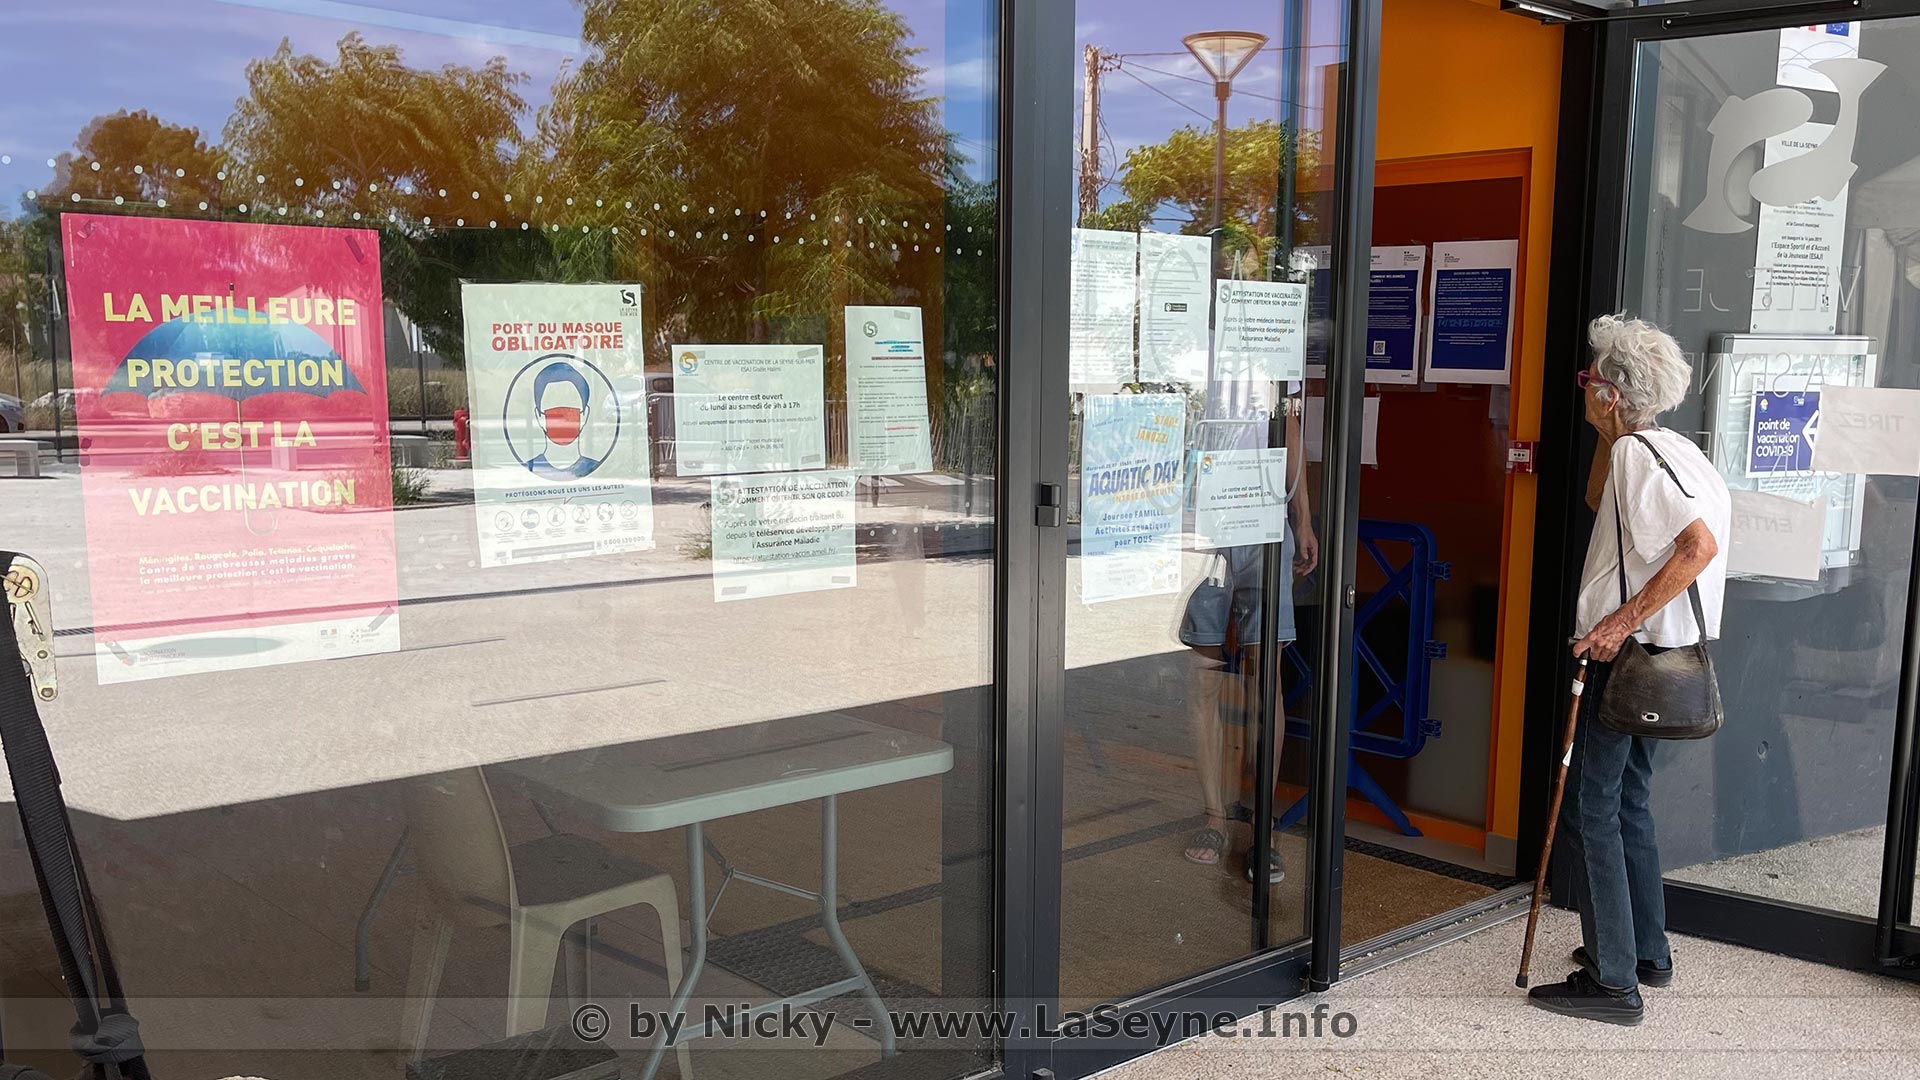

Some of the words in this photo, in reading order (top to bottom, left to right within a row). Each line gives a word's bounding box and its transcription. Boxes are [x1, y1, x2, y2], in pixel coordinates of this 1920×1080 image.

[1772, 242, 1790, 250] l'Espace
[1789, 252, 1809, 260] Jeunesse
[103, 292, 153, 322] LA
[161, 294, 356, 326] MEILLEURE
[492, 323, 533, 335] PORT
[538, 323, 557, 333] DU
[562, 322, 622, 333] MASQUE
[492, 335, 623, 351] OBLIGATOIRE
[126, 358, 344, 388] PROTECTION
[710, 403, 727, 411] lundi
[738, 402, 762, 410] samedi
[763, 402, 772, 410] de
[1758, 420, 1778, 433] point
[1779, 418, 1790, 430] de
[167, 421, 264, 451] C'EST
[275, 420, 317, 448] LA
[1757, 432, 1800, 444] vaccination
[1088, 464, 1151, 497] AQUATIC
[1152, 460, 1180, 486] DAY
[738, 485, 786, 496] ATTESTATION
[789, 484, 797, 492] DE
[128, 479, 355, 516] VACCINATION
[737, 496, 769, 505] COMMENT
[817, 492, 826, 500] QR
[759, 518, 777, 526] votre
[726, 532, 747, 541] depuis
[756, 528, 795, 538] téléservice
[832, 524, 843, 532] par
[794, 537, 820, 546] Maladie
[1114, 539, 1131, 548] pour
[1133, 535, 1153, 544] TOUS
[139, 566, 177, 576] Contre
[181, 564, 195, 572] de
[199, 560, 265, 572] nombreuses
[270, 555, 317, 565] maladies
[321, 554, 356, 564] graves
[140, 576, 151, 585] la
[154, 572, 203, 584] meilleure
[206, 569, 258, 581] protection
[286, 566, 296, 574] la
